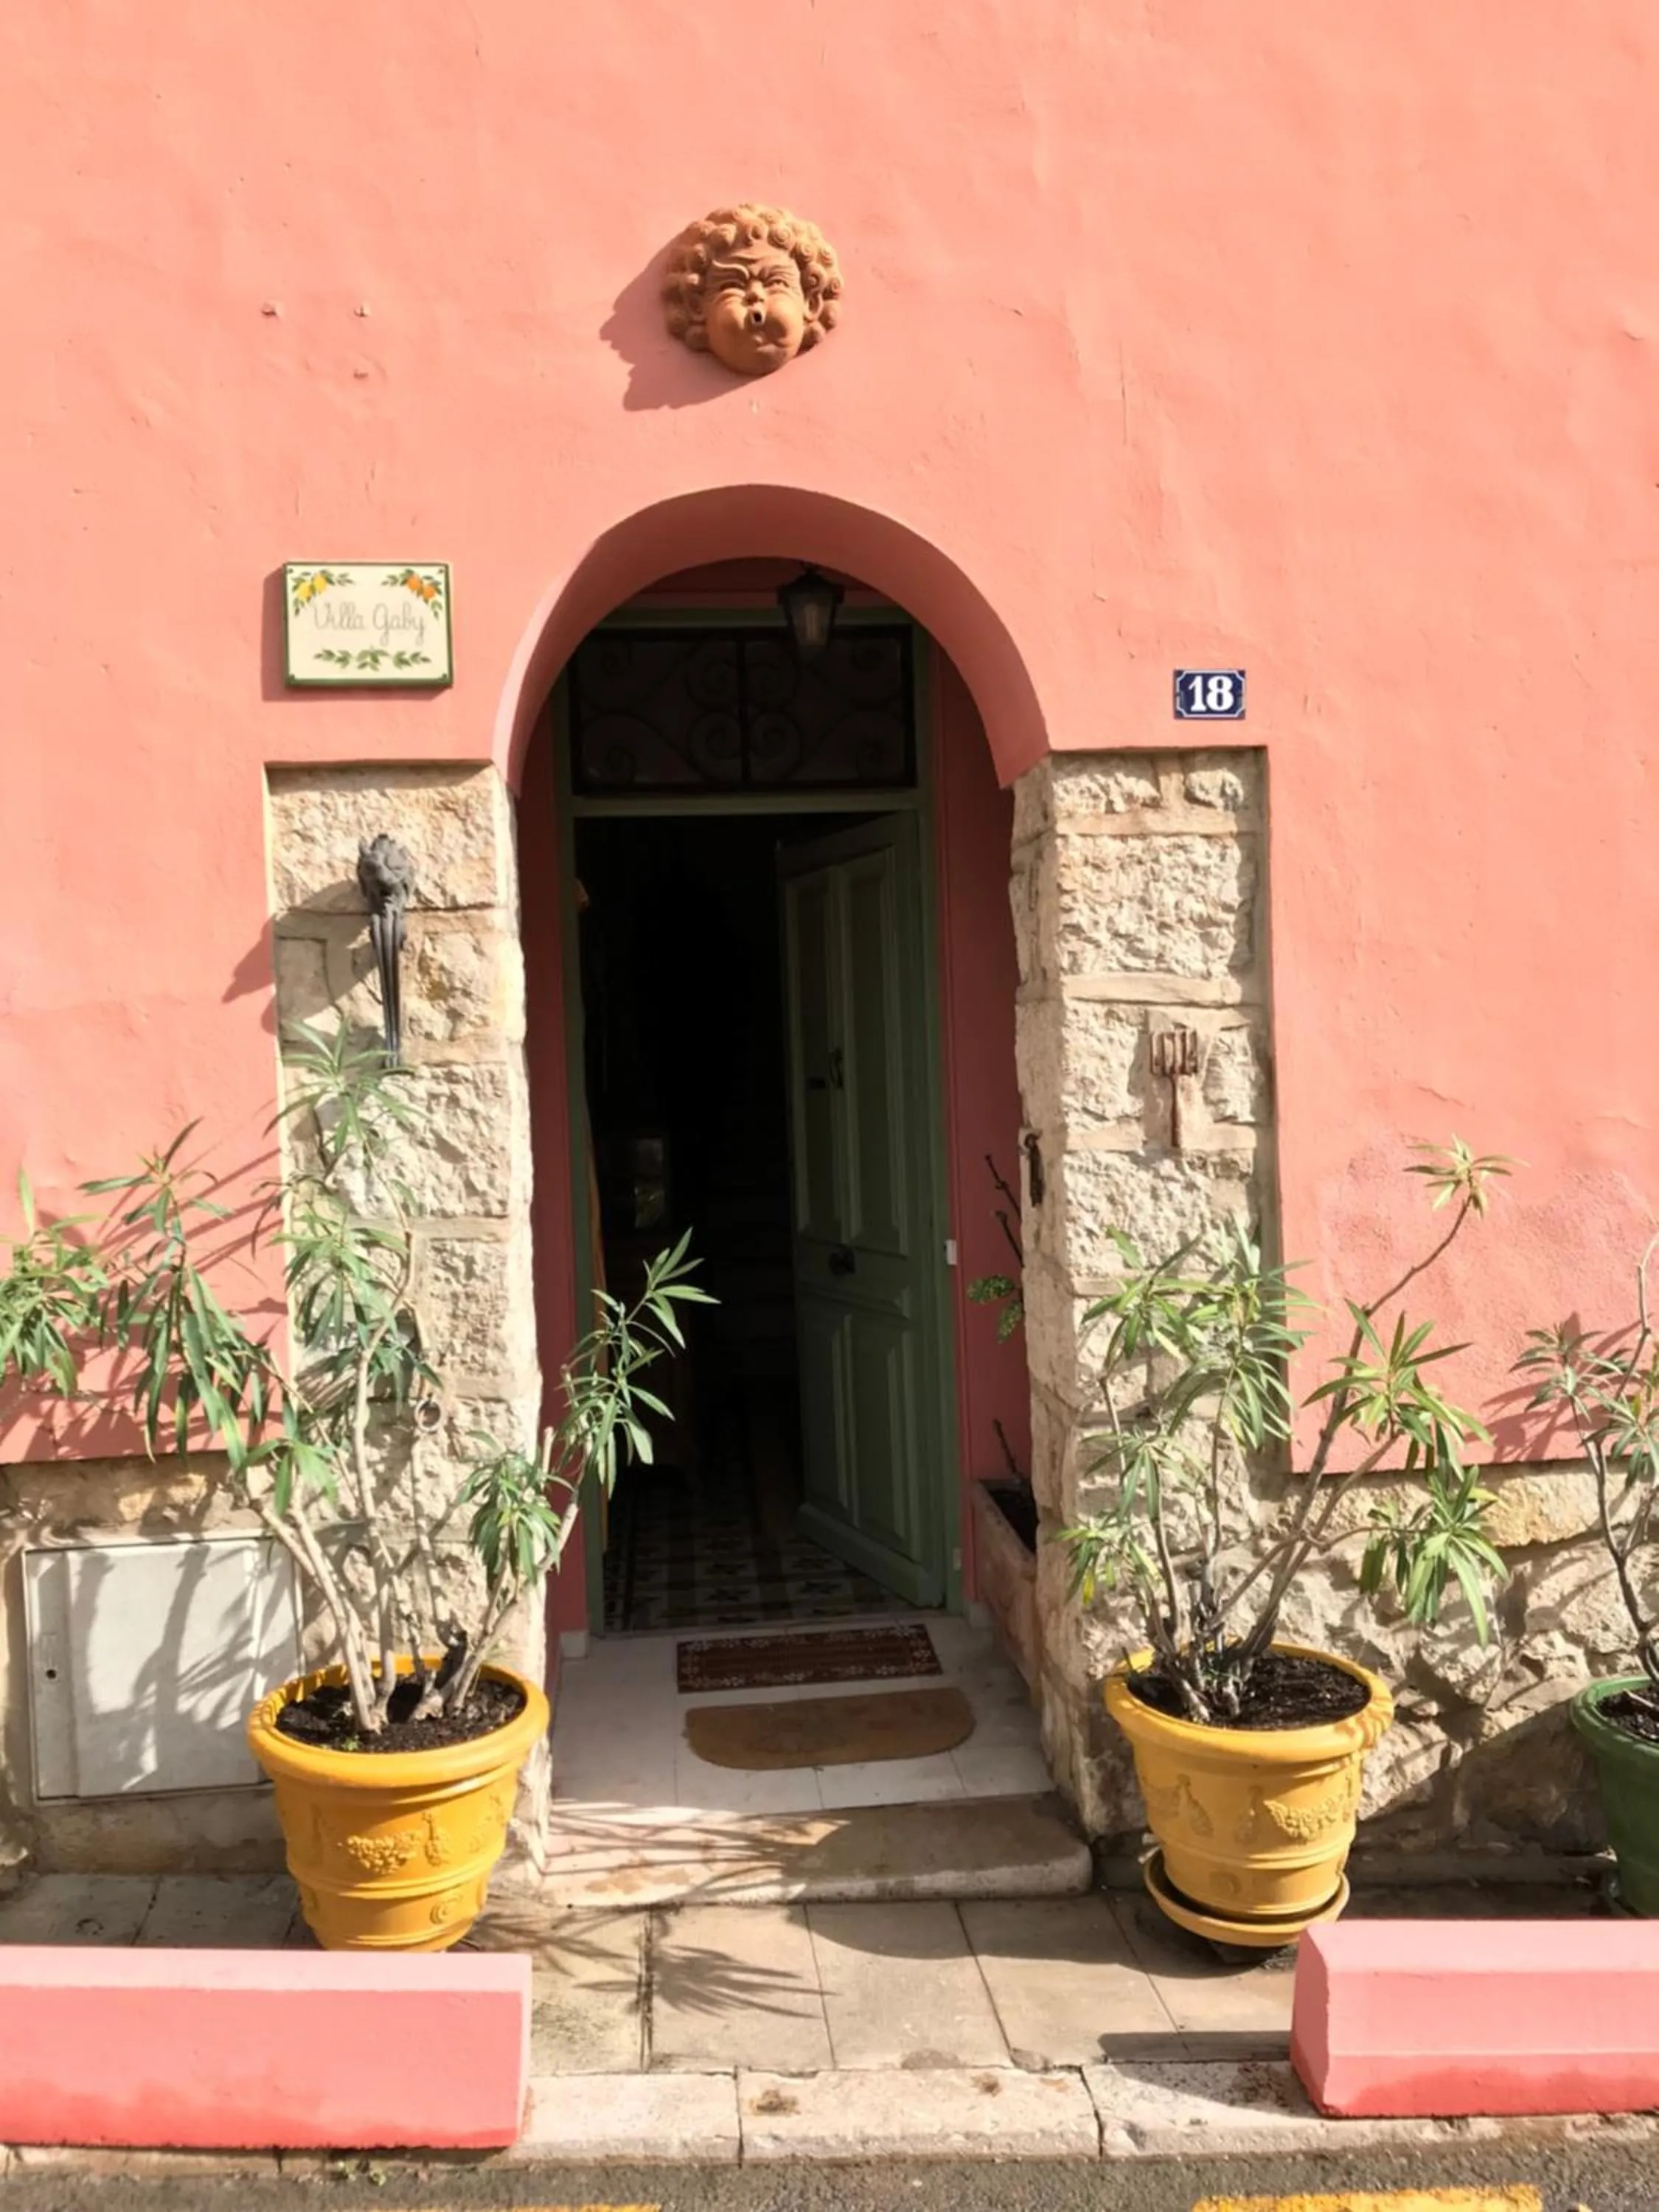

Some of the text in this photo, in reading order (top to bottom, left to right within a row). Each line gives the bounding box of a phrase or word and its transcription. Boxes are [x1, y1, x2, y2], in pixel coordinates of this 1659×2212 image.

[312, 601, 425, 647] Villa Gaby
[1188, 675, 1234, 712] 18
